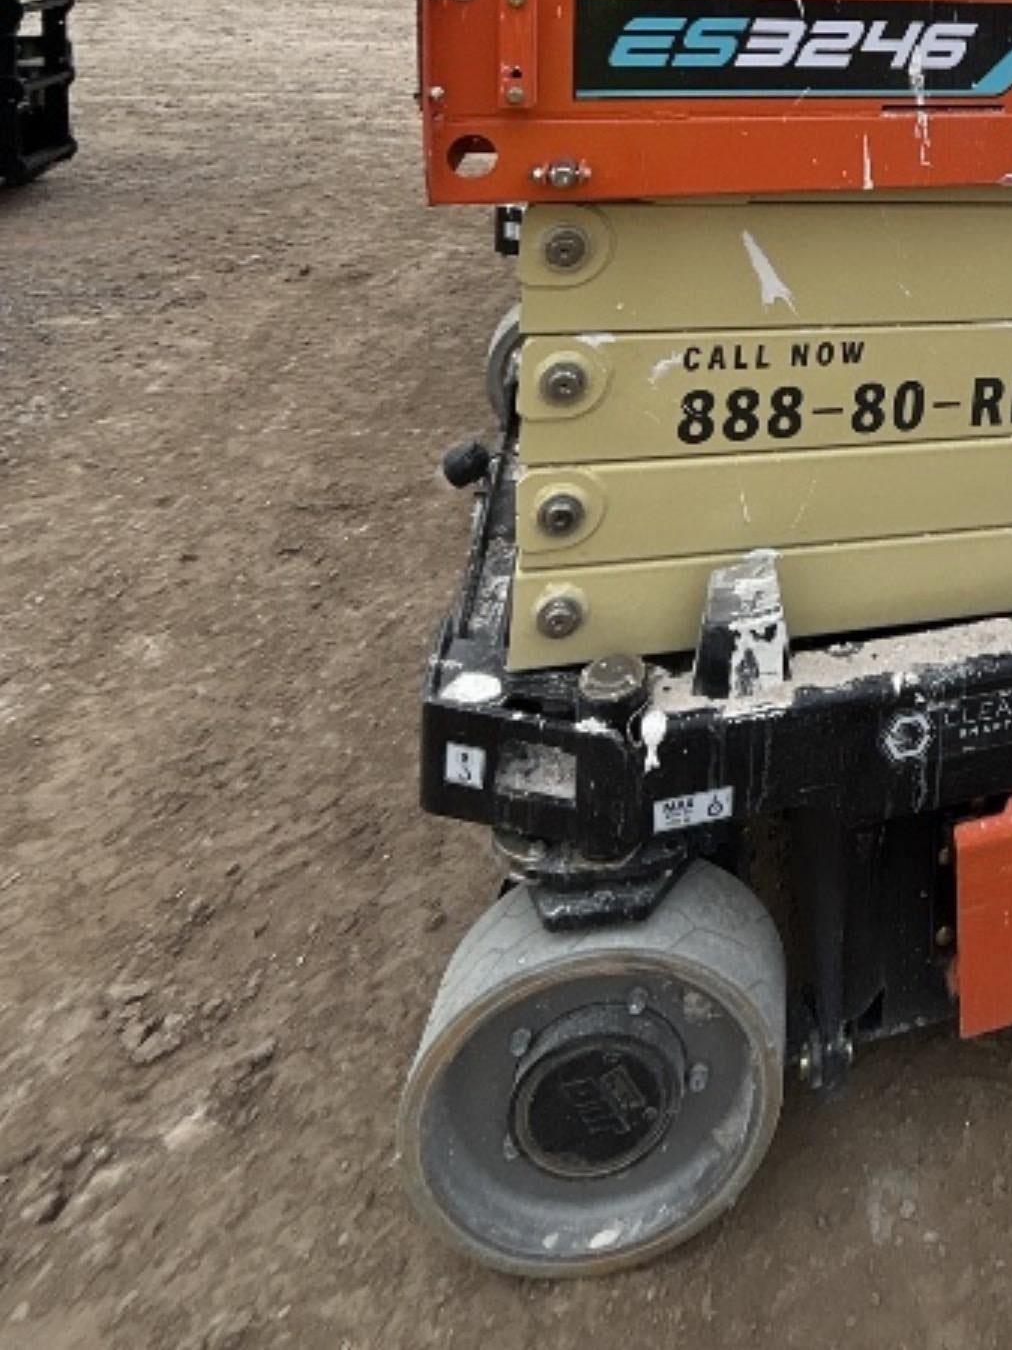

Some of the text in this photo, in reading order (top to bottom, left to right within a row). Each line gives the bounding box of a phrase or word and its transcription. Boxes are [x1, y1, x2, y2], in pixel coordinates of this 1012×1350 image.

[608, 16, 979, 69] ES3246
[683, 341, 865, 371] CALL NOW
